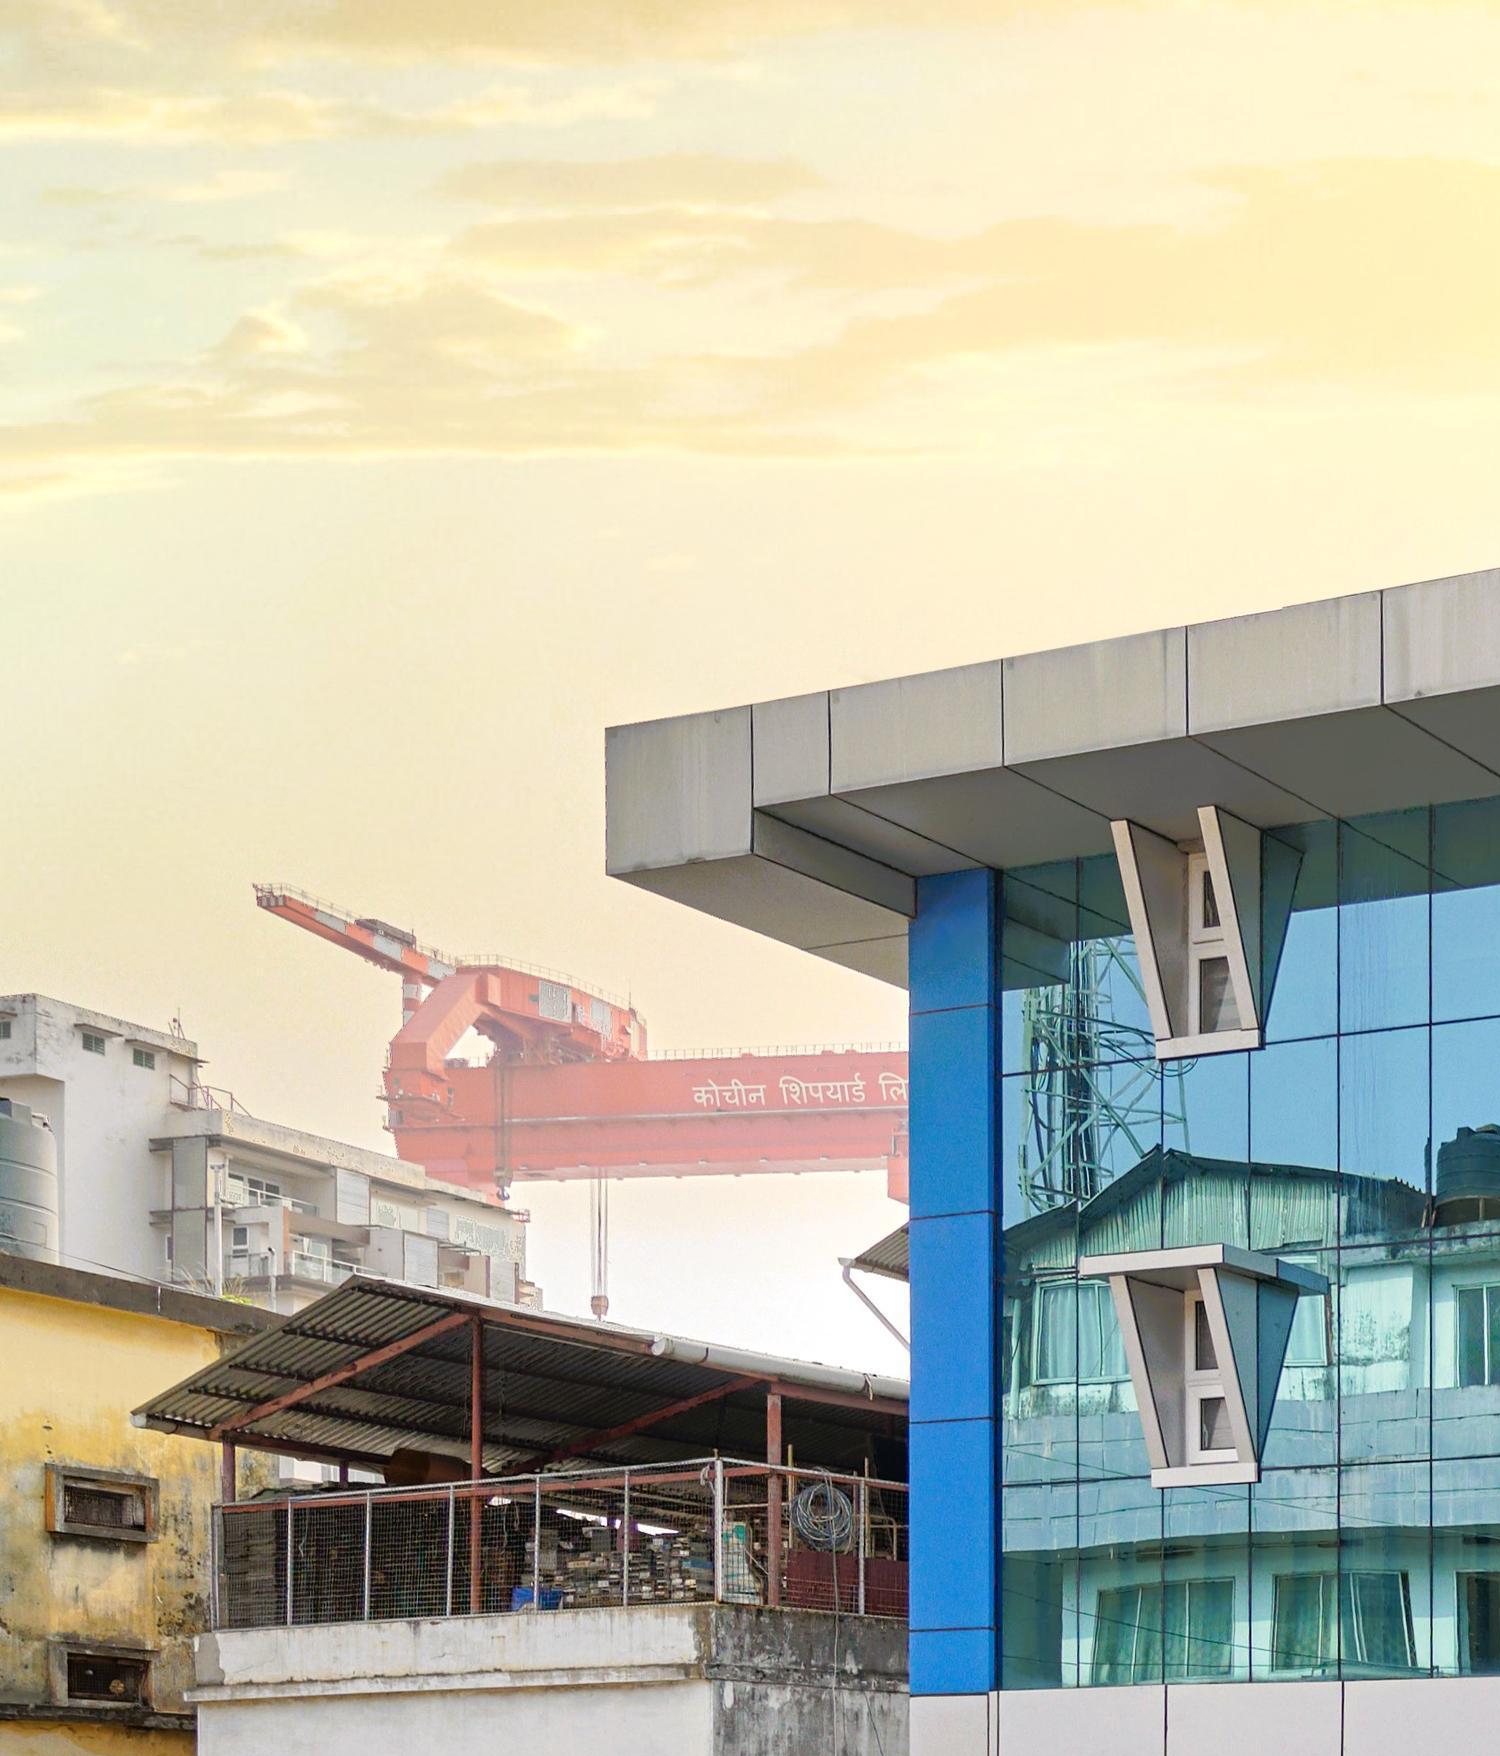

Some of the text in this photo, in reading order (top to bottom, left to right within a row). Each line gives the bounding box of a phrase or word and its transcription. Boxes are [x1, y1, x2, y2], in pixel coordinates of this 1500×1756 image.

[692, 1072, 908, 1107] कोचीन शिपयार्ड लि
